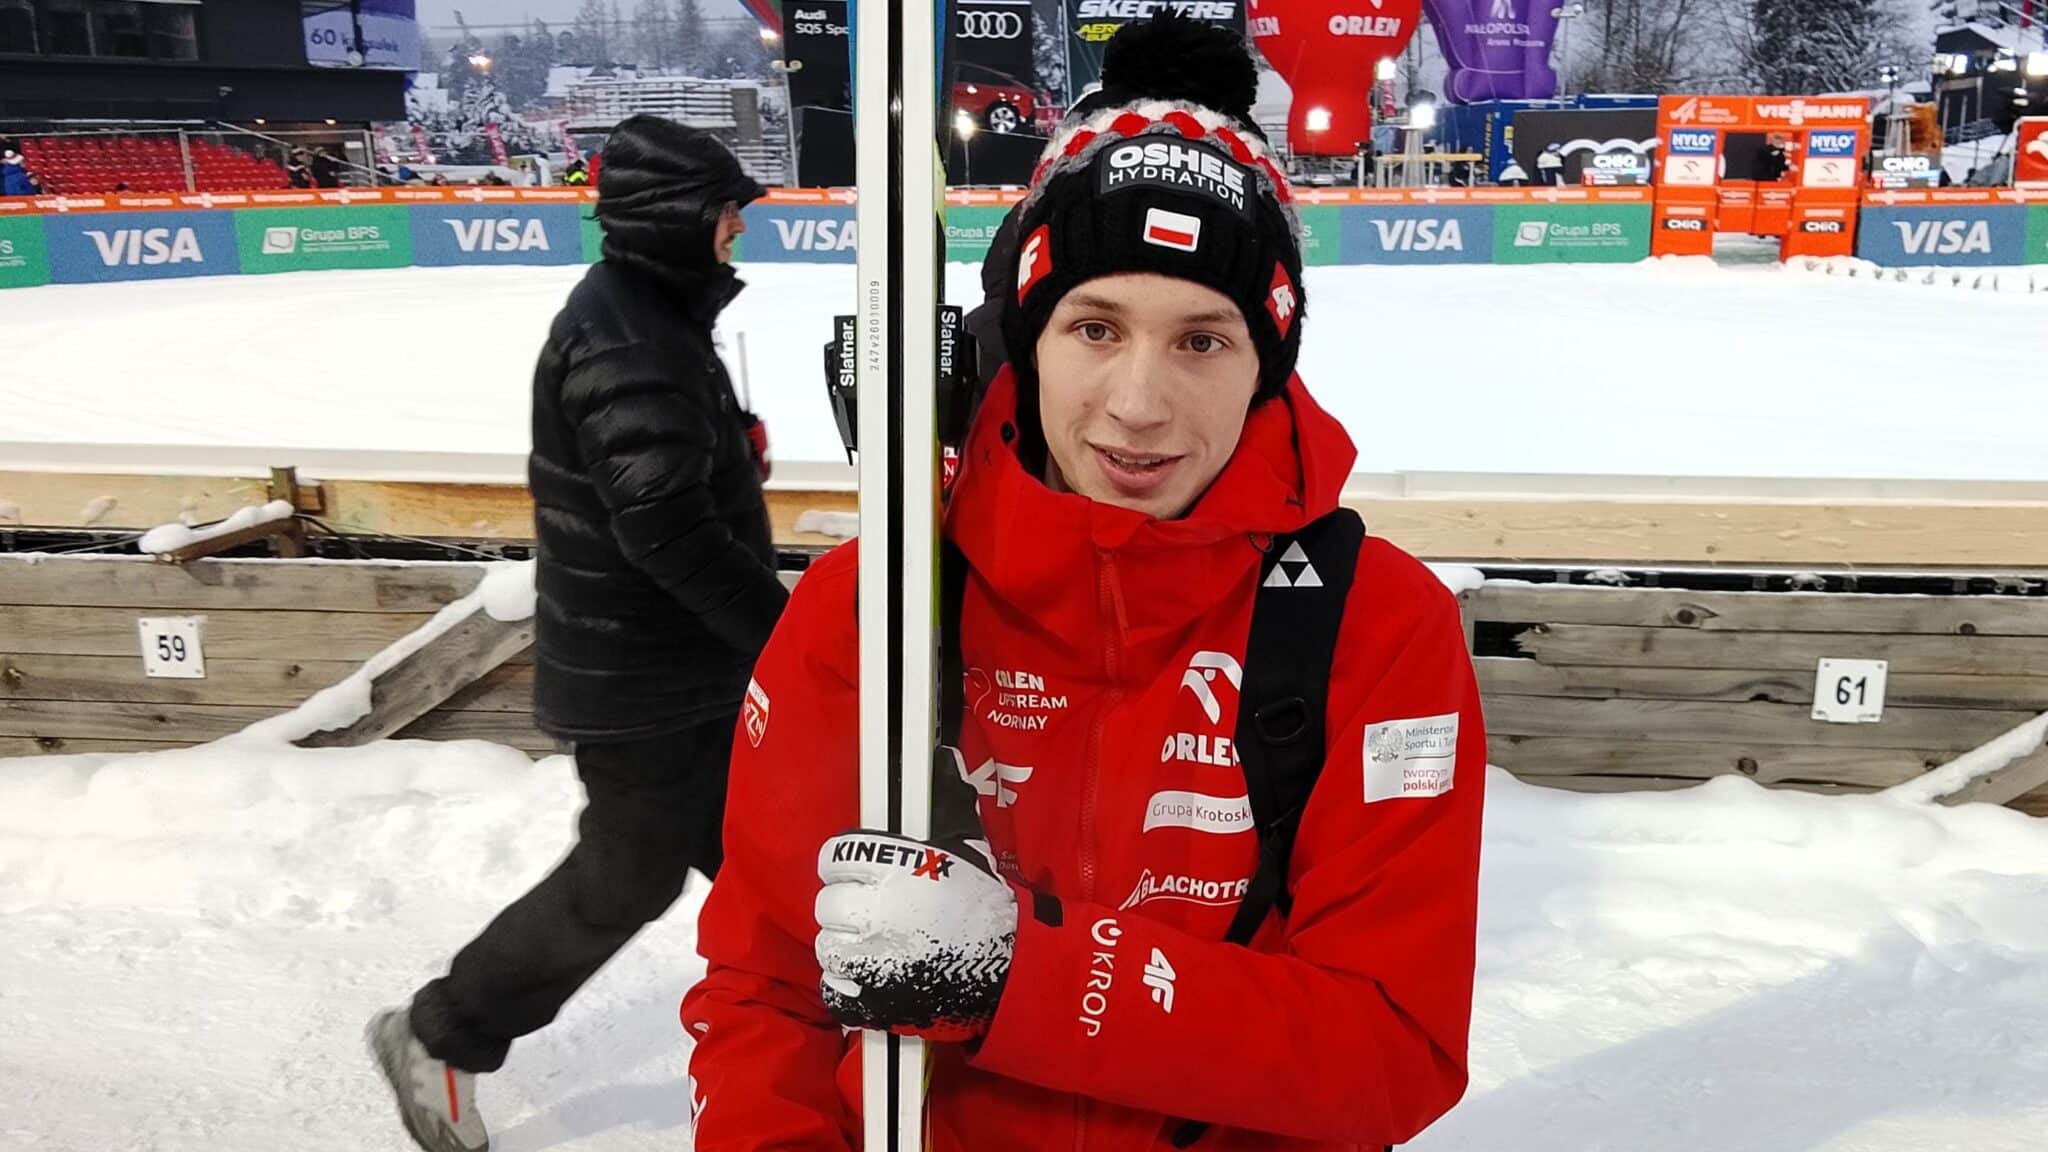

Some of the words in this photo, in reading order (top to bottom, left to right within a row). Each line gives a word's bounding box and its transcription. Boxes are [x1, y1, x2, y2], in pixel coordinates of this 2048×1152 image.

[794, 9, 827, 20] Audi
[1328, 15, 1401, 37] ORLEN
[311, 29, 336, 45] 60
[795, 23, 822, 35] SQ5
[1110, 143, 1245, 195] OSHEE
[1109, 166, 1244, 210] HYDRATION
[301, 229, 345, 242] Grupa
[347, 226, 380, 239] BPS
[442, 218, 549, 251] VISA
[1370, 218, 1463, 251] VISA
[1551, 224, 1588, 236] Grupa
[1591, 223, 1621, 235] BPS
[1891, 220, 1992, 254] VISA
[83, 227, 204, 266] VISA
[840, 319, 855, 387] Slatnar.
[157, 635, 186, 662] 59
[1836, 676, 1867, 705] 61
[1403, 780, 1438, 792] polski
[1152, 803, 1192, 817] Grupa
[1143, 947, 1176, 1013] 4F
